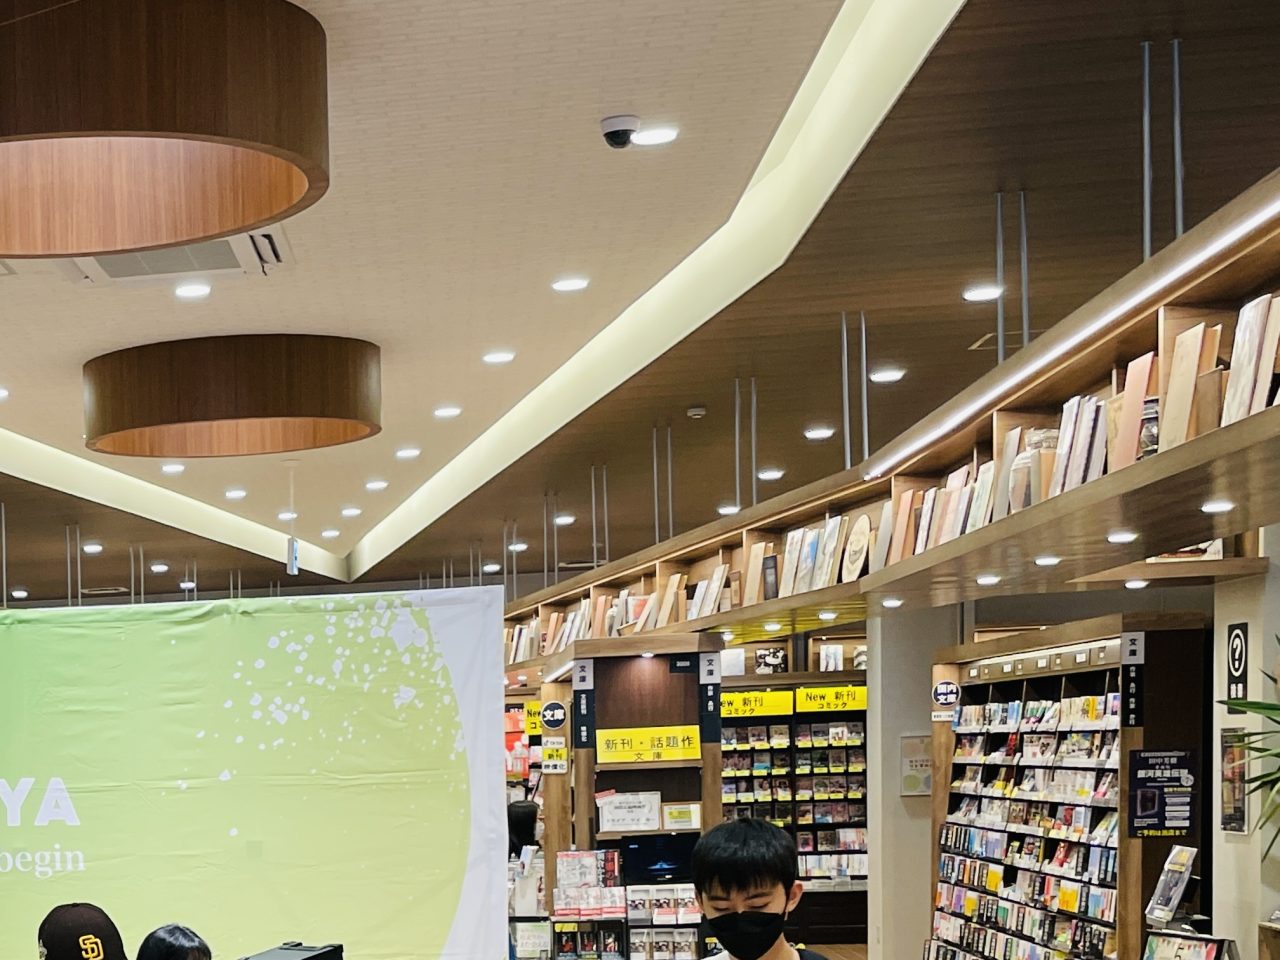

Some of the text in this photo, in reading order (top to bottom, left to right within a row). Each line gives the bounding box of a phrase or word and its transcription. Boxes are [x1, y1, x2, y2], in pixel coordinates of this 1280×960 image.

[720, 696, 763, 707] ew 新刊
[806, 690, 856, 702] New 新刊
[542, 709, 565, 721] 文庫
[605, 735, 695, 750] 新刊・話題作
[634, 752, 662, 761] 文庫
